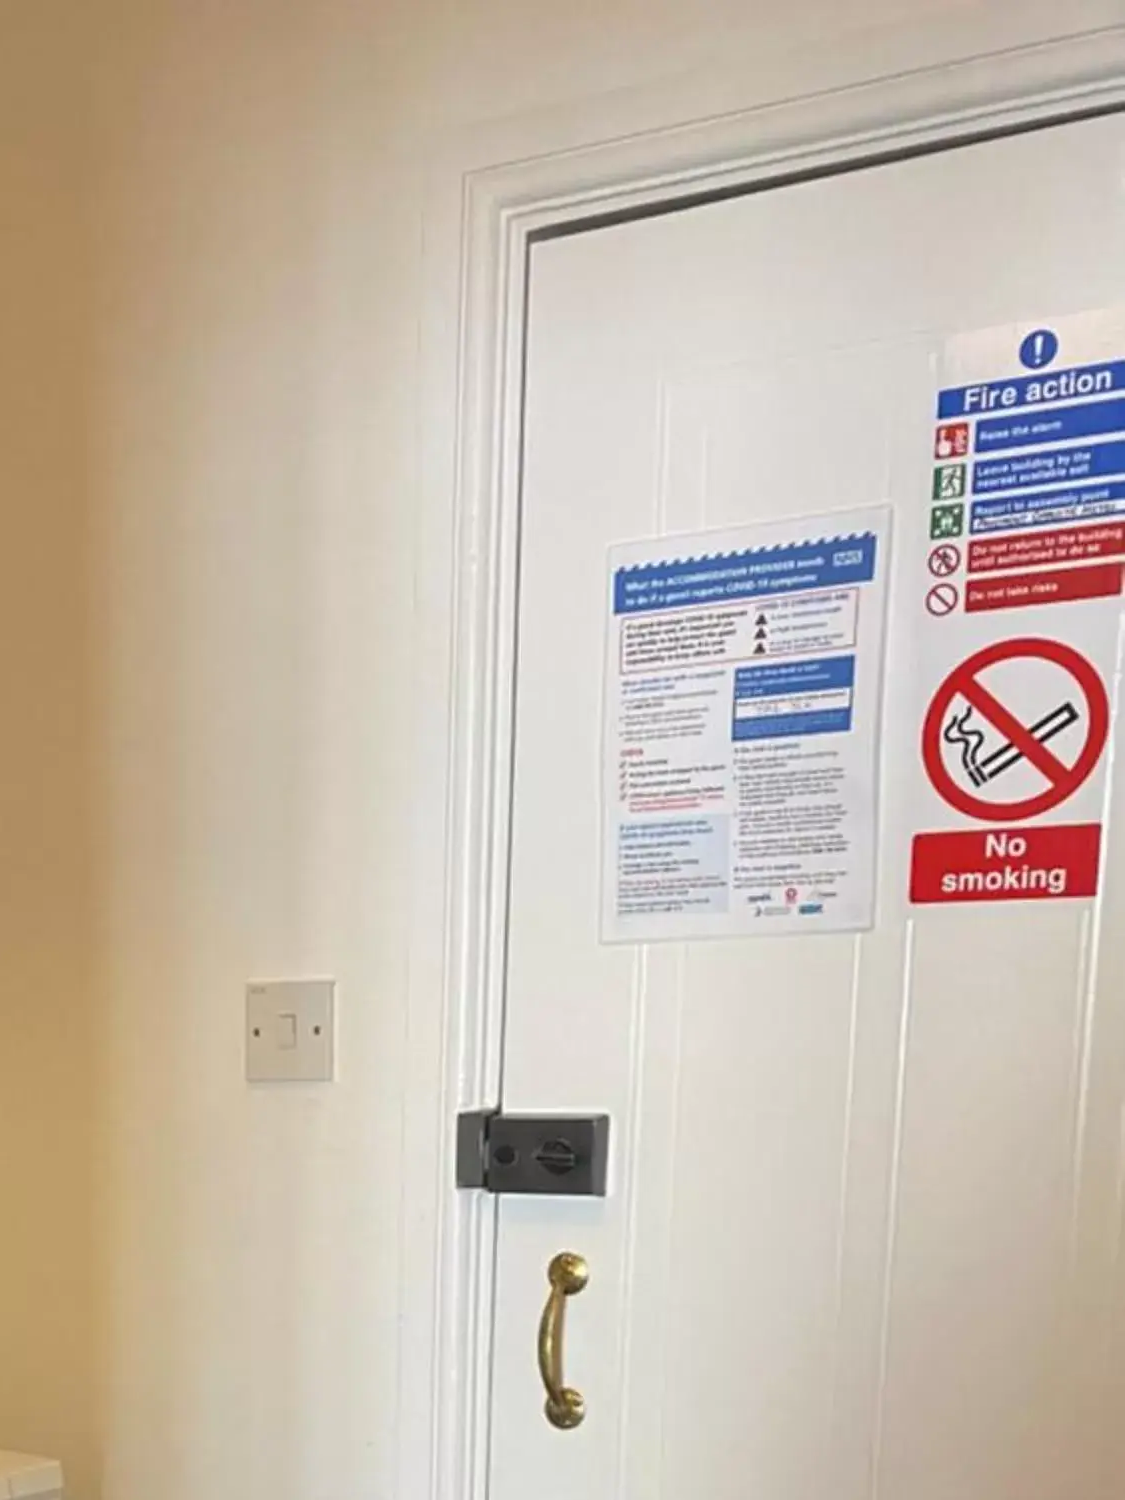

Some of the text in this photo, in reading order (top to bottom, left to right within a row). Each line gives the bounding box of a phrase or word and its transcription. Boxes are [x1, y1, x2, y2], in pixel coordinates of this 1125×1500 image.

[963, 368, 1113, 412] Fire action
[1012, 425, 1029, 436] the
[1031, 421, 1063, 433] alarm
[977, 451, 1091, 477] Leave building by the
[1019, 468, 1067, 482] available
[1069, 463, 1090, 475] exit
[972, 528, 1123, 556] Do not return to the building
[1055, 547, 1067, 557] to
[1069, 545, 1084, 556] do
[969, 582, 1059, 601] Do not take risks
[984, 832, 1027, 858] No
[941, 864, 1067, 894] smoking
